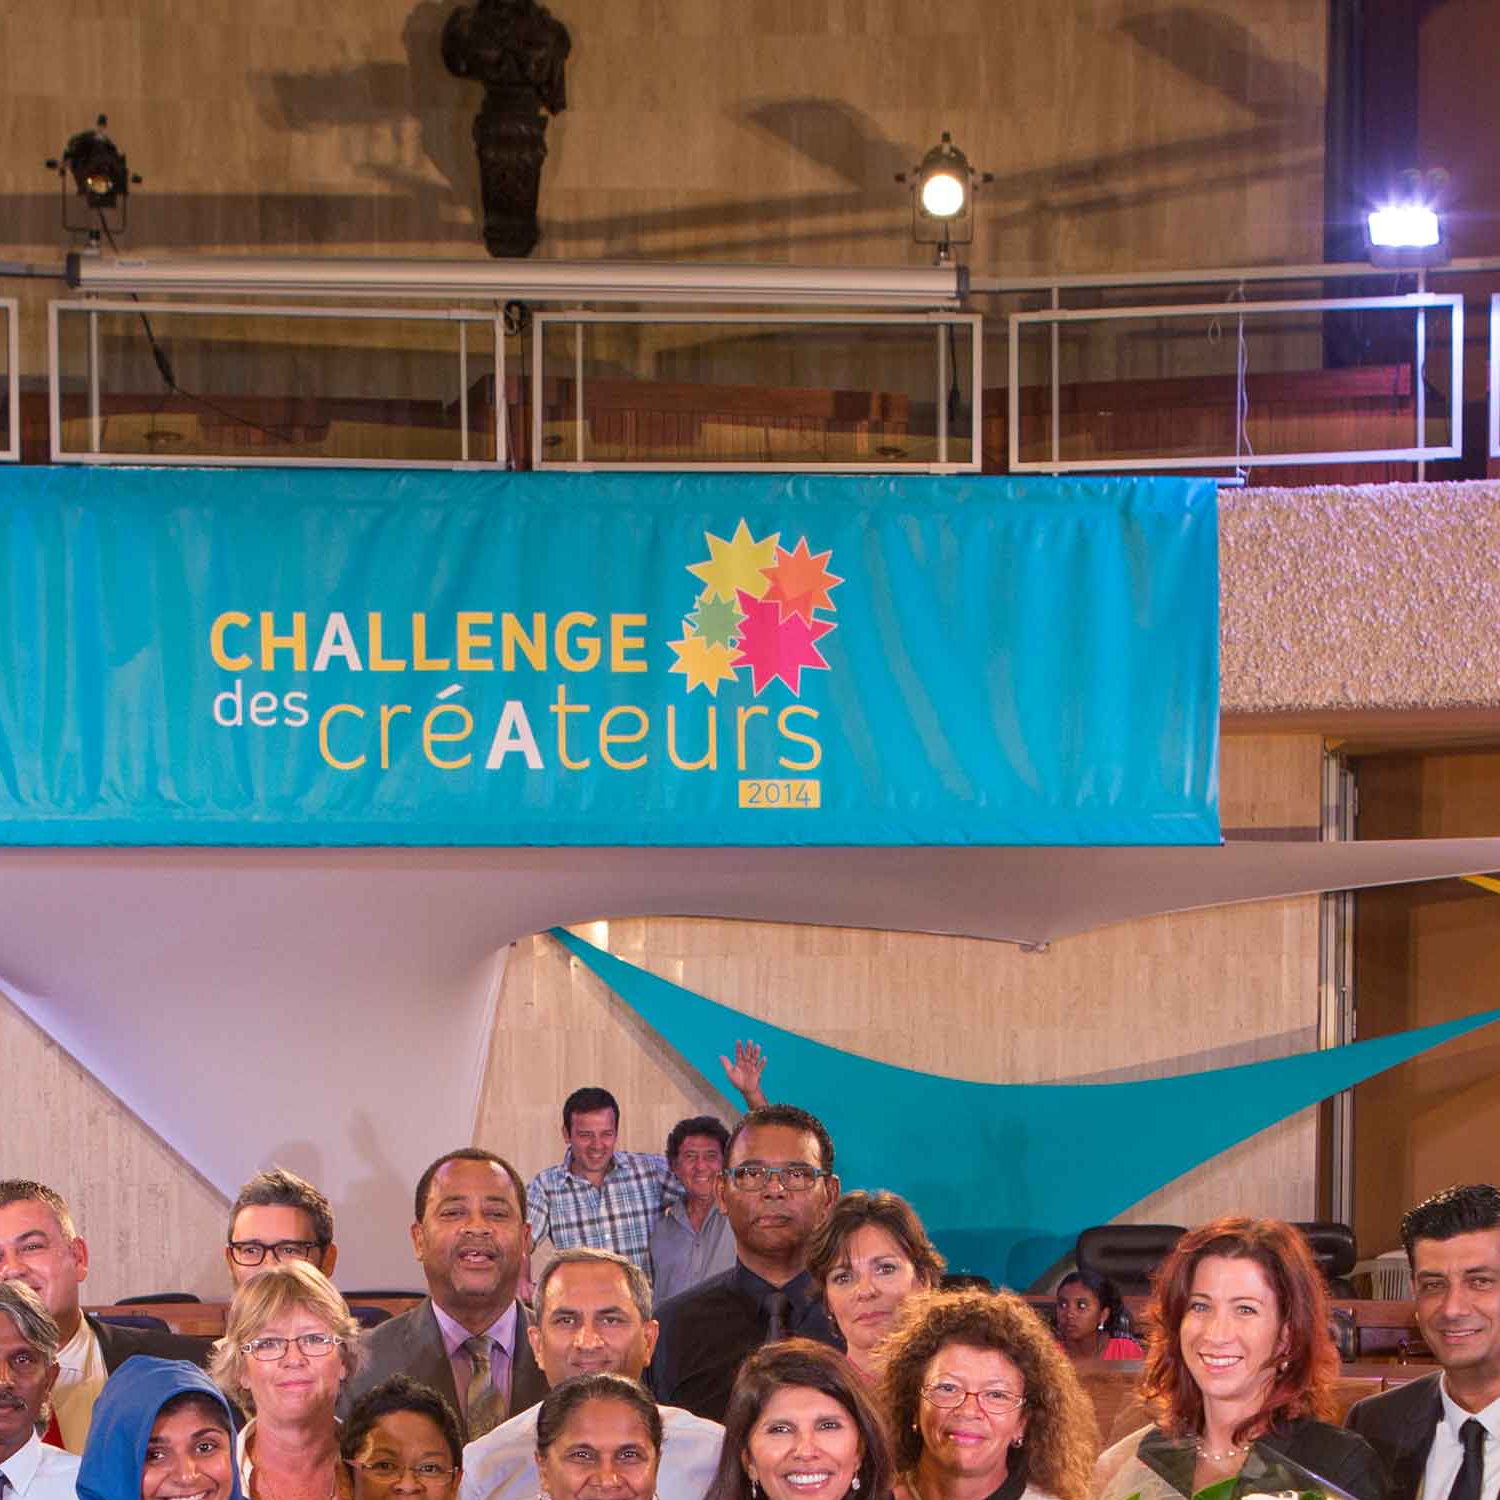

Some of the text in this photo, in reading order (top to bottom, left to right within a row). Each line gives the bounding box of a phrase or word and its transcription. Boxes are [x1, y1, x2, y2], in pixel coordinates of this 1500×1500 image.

[210, 612, 648, 673] CHALLENGE
[213, 680, 824, 771] des créAteurs
[747, 782, 812, 806] 2014
